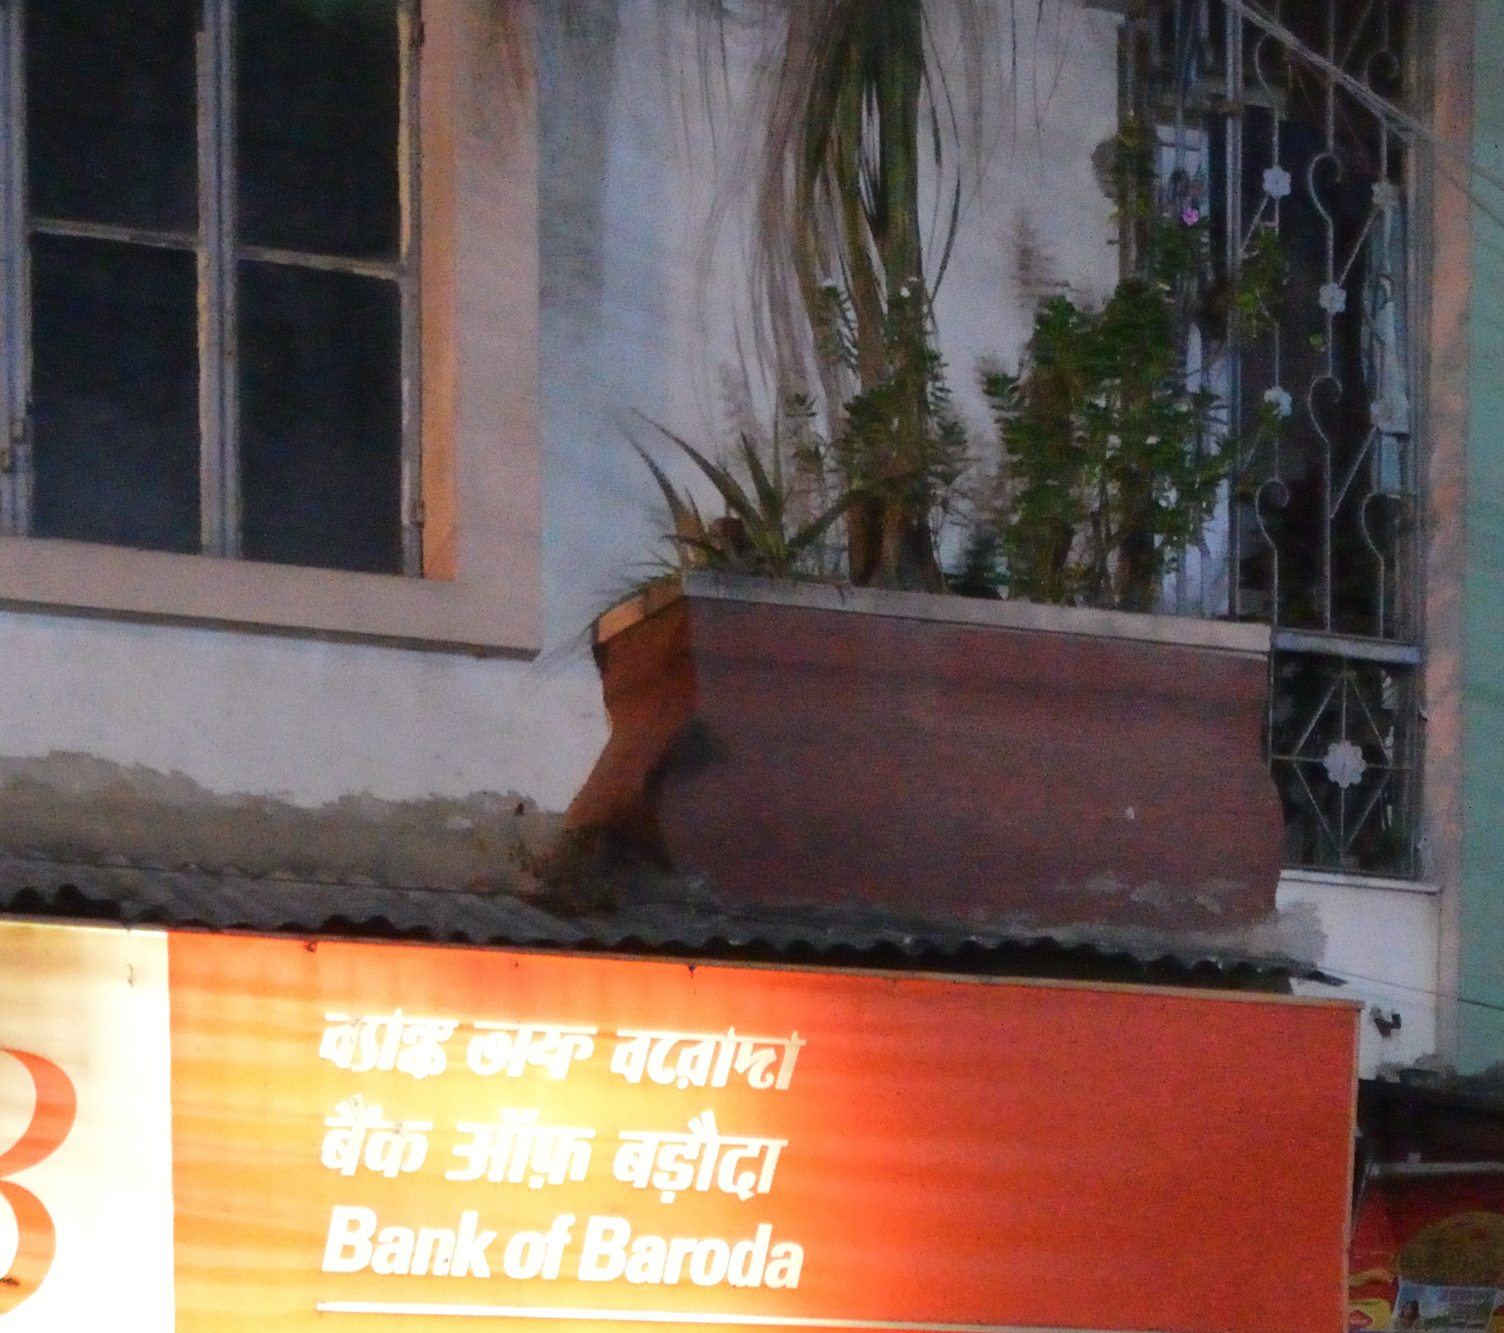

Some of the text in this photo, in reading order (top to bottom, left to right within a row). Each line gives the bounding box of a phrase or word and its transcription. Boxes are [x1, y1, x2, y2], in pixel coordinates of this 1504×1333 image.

[466, 1021, 598, 1079] অফ
[610, 1026, 806, 1090] বরোদা
[612, 1110, 789, 1203] बड़ौदा
[321, 1206, 805, 1289] Bank of Baroda
